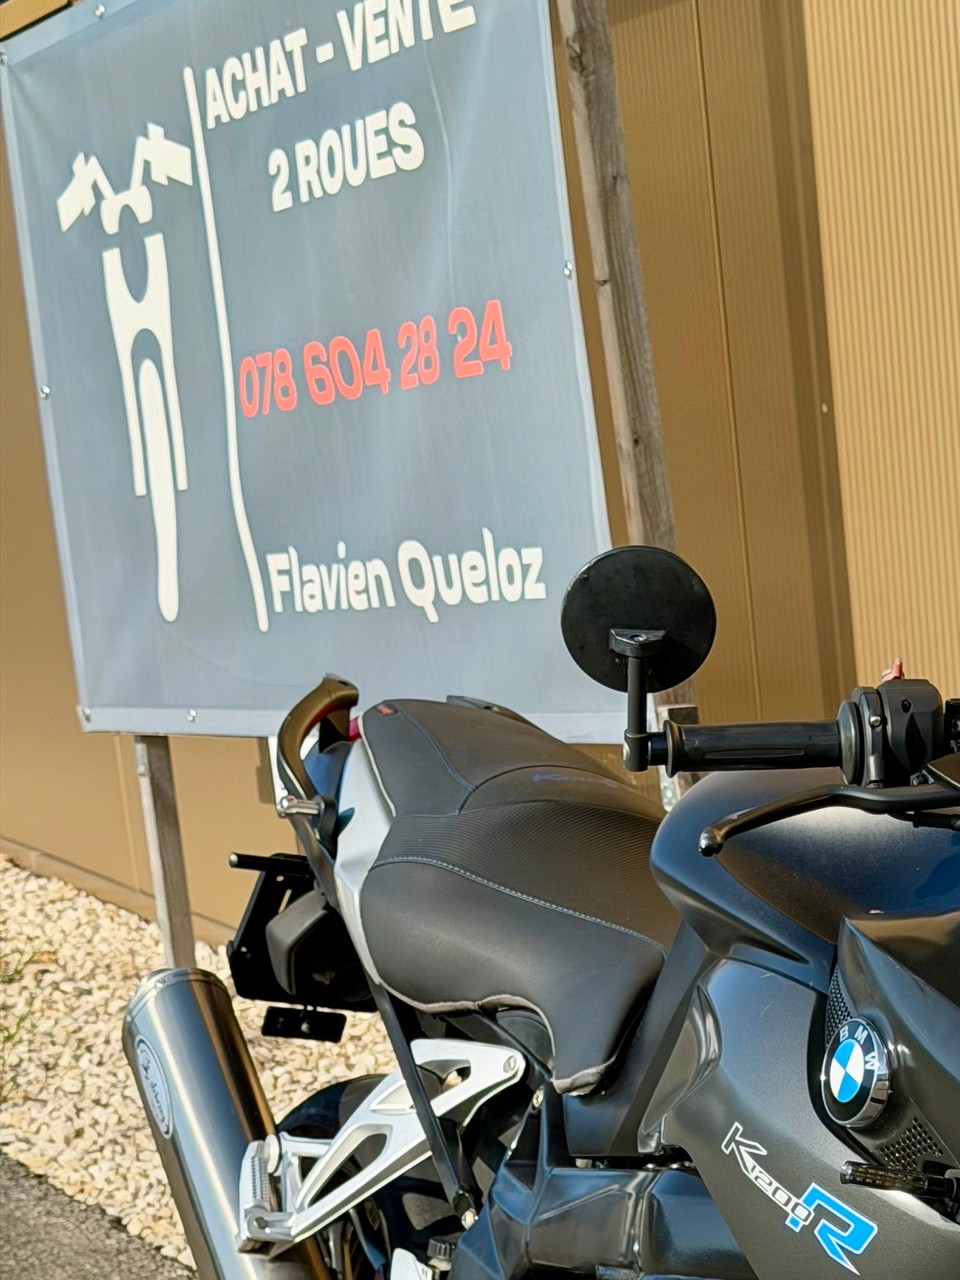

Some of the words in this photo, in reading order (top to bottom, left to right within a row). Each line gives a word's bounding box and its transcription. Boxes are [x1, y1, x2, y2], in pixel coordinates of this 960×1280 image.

[205, 28, 308, 129] ACHAT
[268, 148, 294, 212] 2
[295, 102, 425, 203] ROUES
[239, 348, 297, 418] 078
[303, 328, 391, 405] 604
[398, 315, 440, 390] 28
[448, 299, 512, 378] 24
[265, 541, 396, 613] Flavien
[397, 526, 547, 623] Queloz
[839, 1025, 878, 1071] BMW
